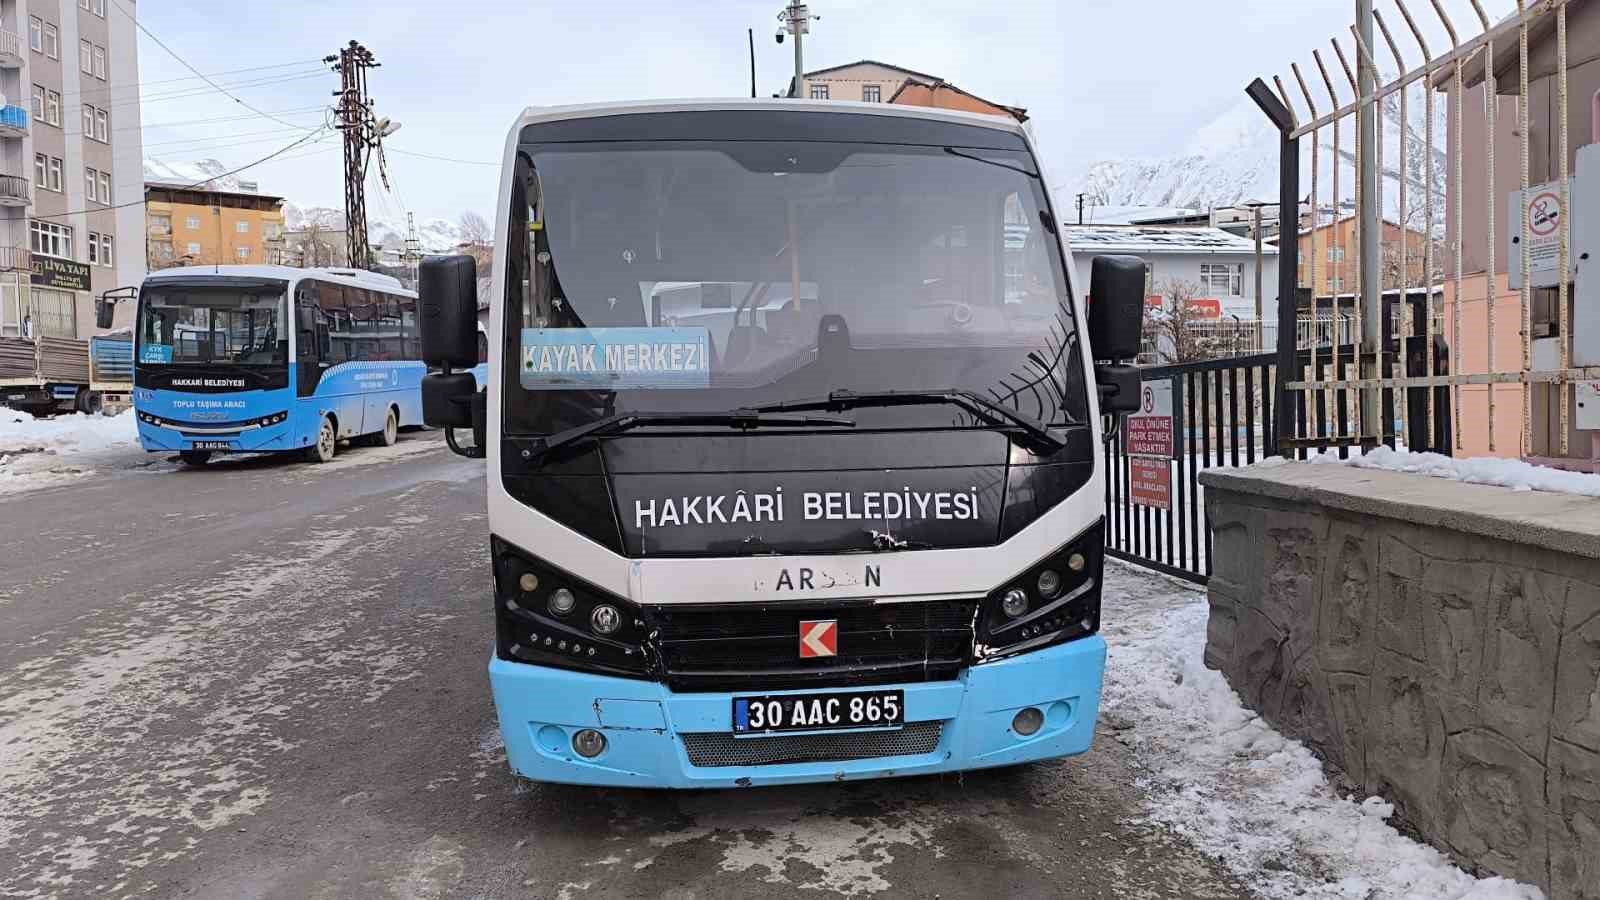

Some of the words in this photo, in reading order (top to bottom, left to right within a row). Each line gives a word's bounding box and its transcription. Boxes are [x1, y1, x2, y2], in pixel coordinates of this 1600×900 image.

[523, 345, 597, 373] KAYAK
[604, 336, 706, 372] MERKEZİ
[204, 378, 245, 387] BELEDİYESİ
[173, 400, 195, 408] TOPLU
[196, 400, 223, 409] TAŞIMA
[223, 400, 246, 408] ARACI
[1129, 431, 1147, 441] PARK
[1147, 431, 1170, 442] ETMEK
[635, 486, 784, 528] HAKKÂRİ
[803, 486, 979, 520] BELEDİYESİ
[750, 701, 783, 728] 30
[791, 698, 841, 726] AAC
[850, 695, 899, 723] 865
